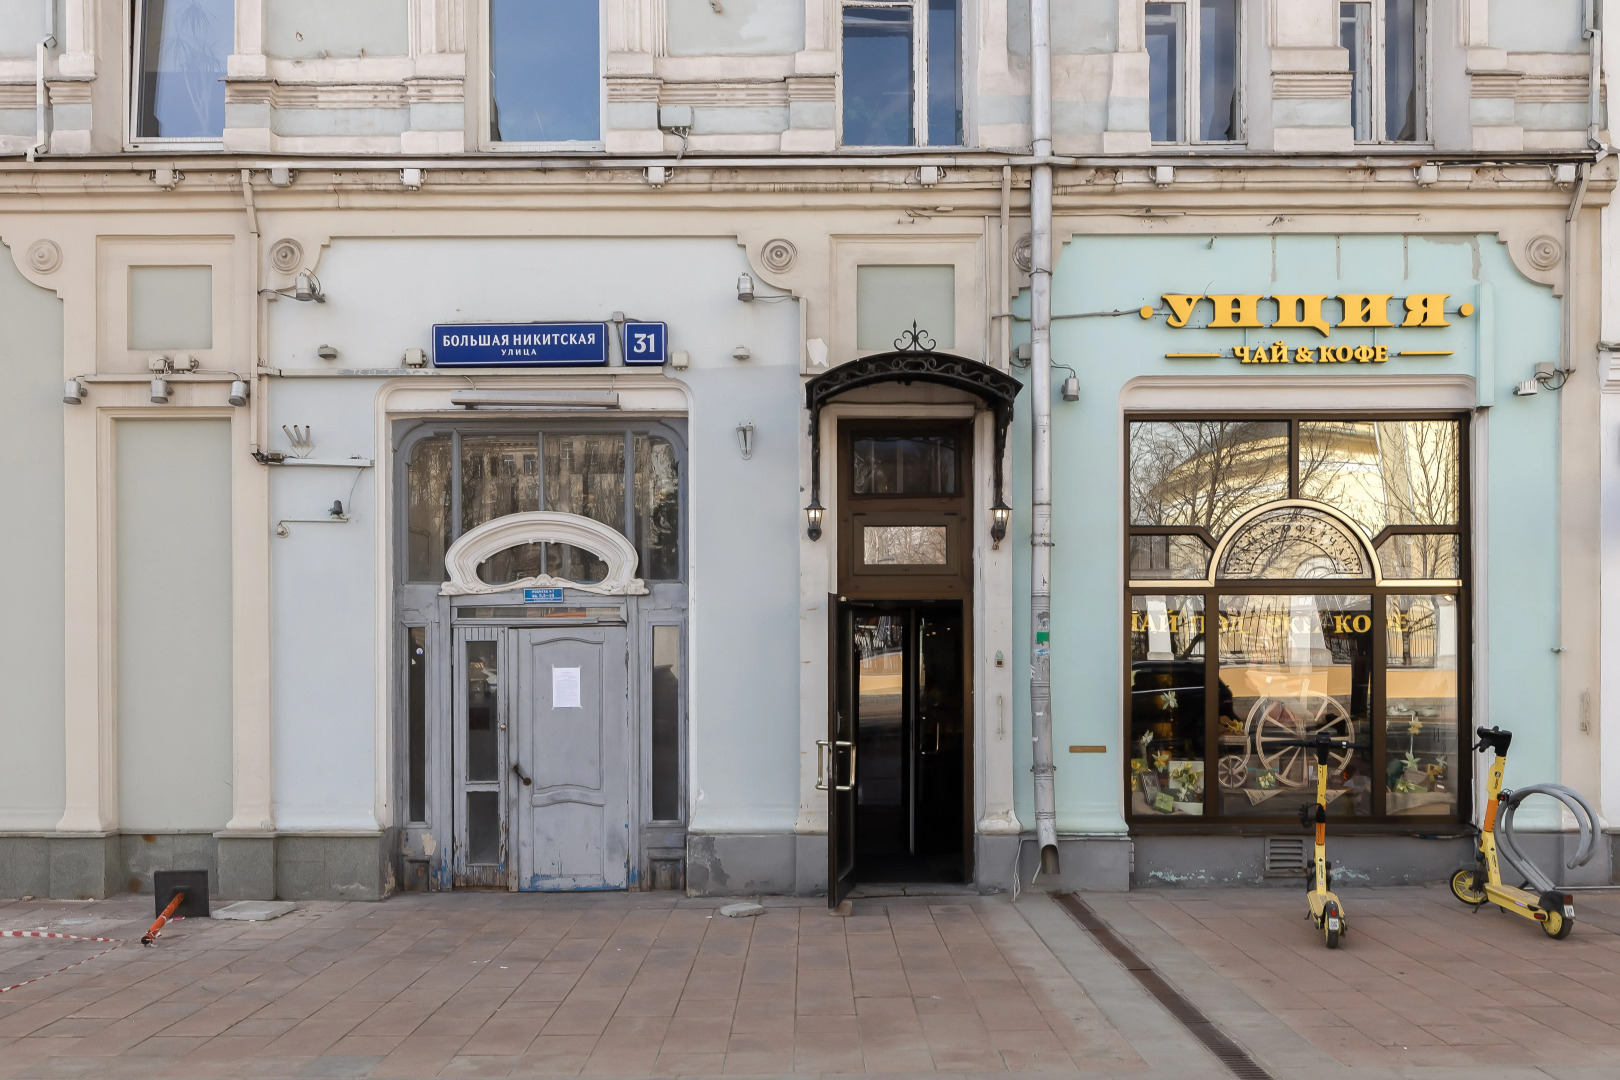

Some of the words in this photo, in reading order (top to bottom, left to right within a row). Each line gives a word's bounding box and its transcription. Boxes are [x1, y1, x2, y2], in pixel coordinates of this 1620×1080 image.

[1162, 293, 1451, 338] УНЦИЯ
[442, 334, 509, 347] БОЛЬШАЯ
[513, 333, 596, 346] НИКИТСКАЯ
[633, 333, 656, 353] 31
[501, 348, 537, 356] УЛИЦА
[1233, 340, 1290, 364] ЧАЙ
[1295, 346, 1314, 363] &
[1318, 345, 1389, 364] КОФЕ
